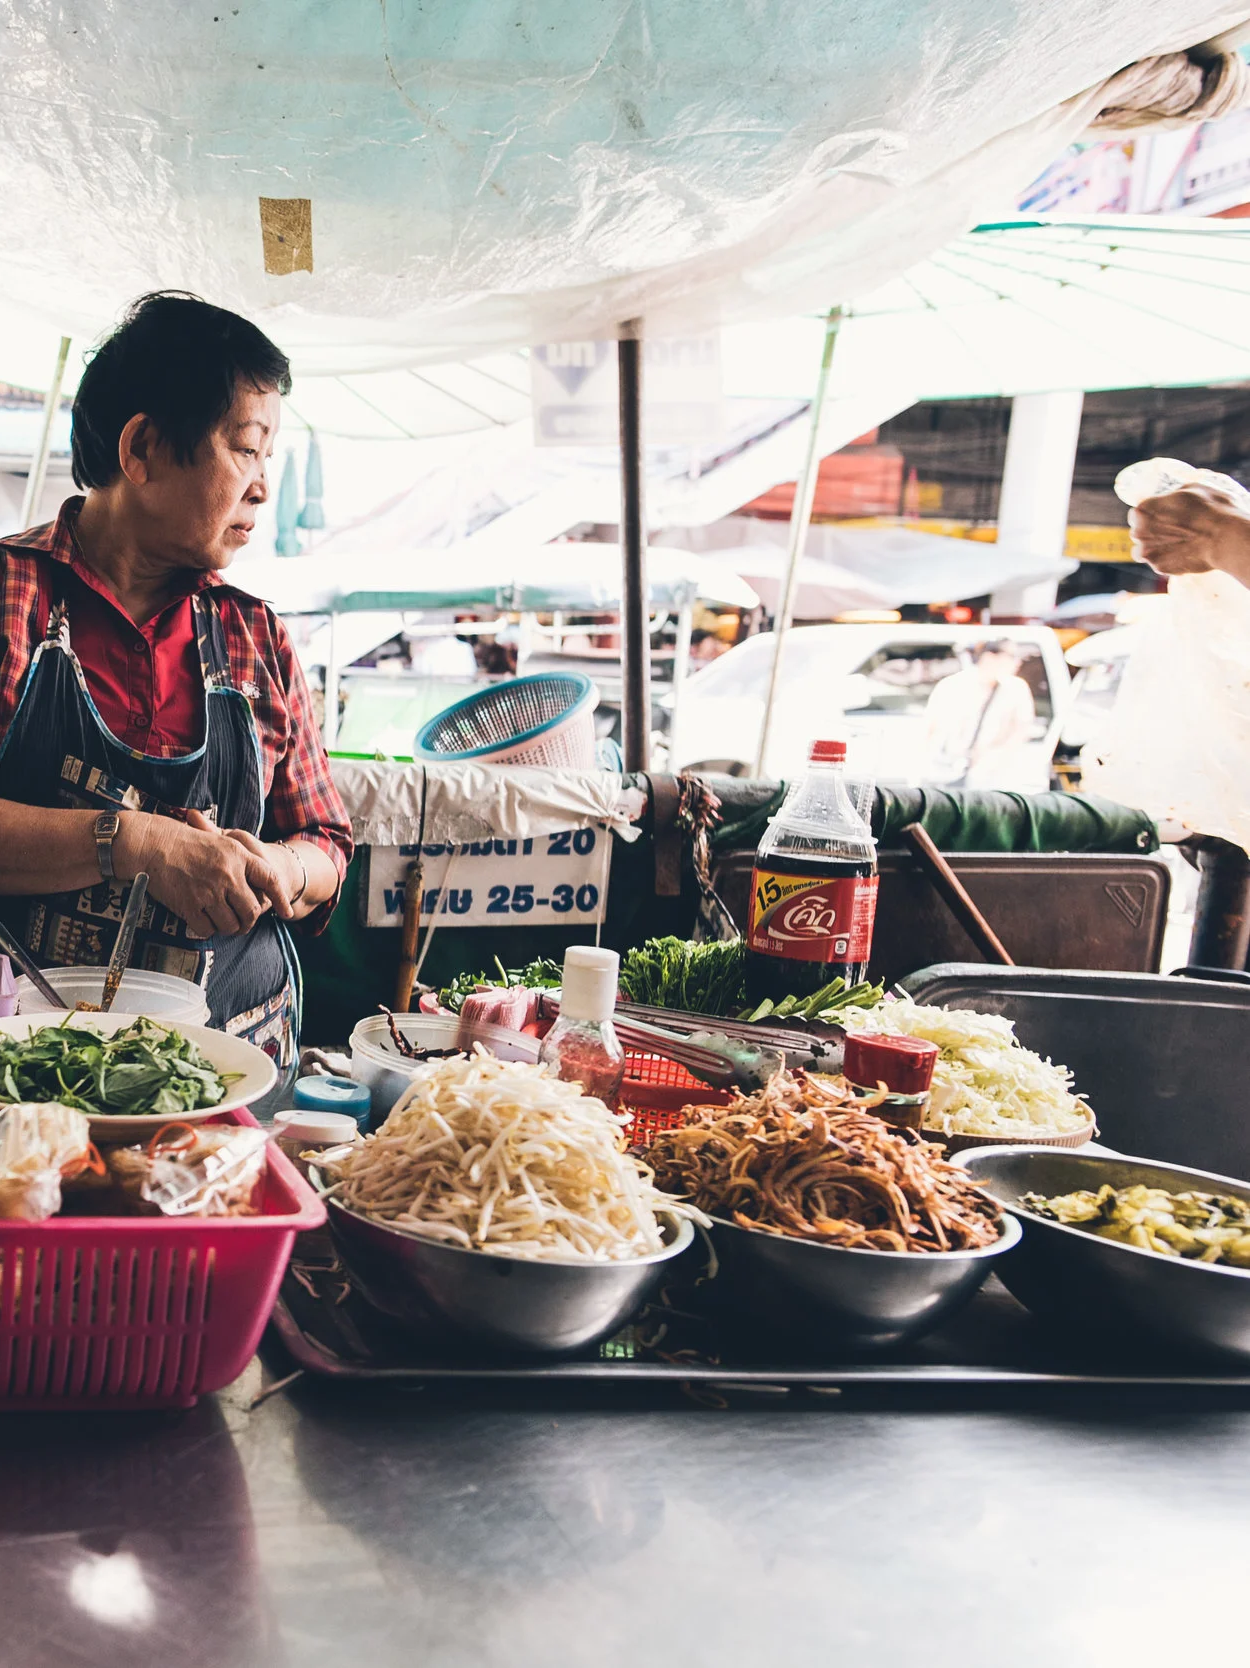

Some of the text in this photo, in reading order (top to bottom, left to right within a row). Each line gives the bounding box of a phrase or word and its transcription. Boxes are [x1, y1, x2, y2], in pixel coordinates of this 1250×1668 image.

[547, 828, 596, 856] 20
[486, 884, 598, 914] 25-30
[757, 875, 782, 912] 1.5
